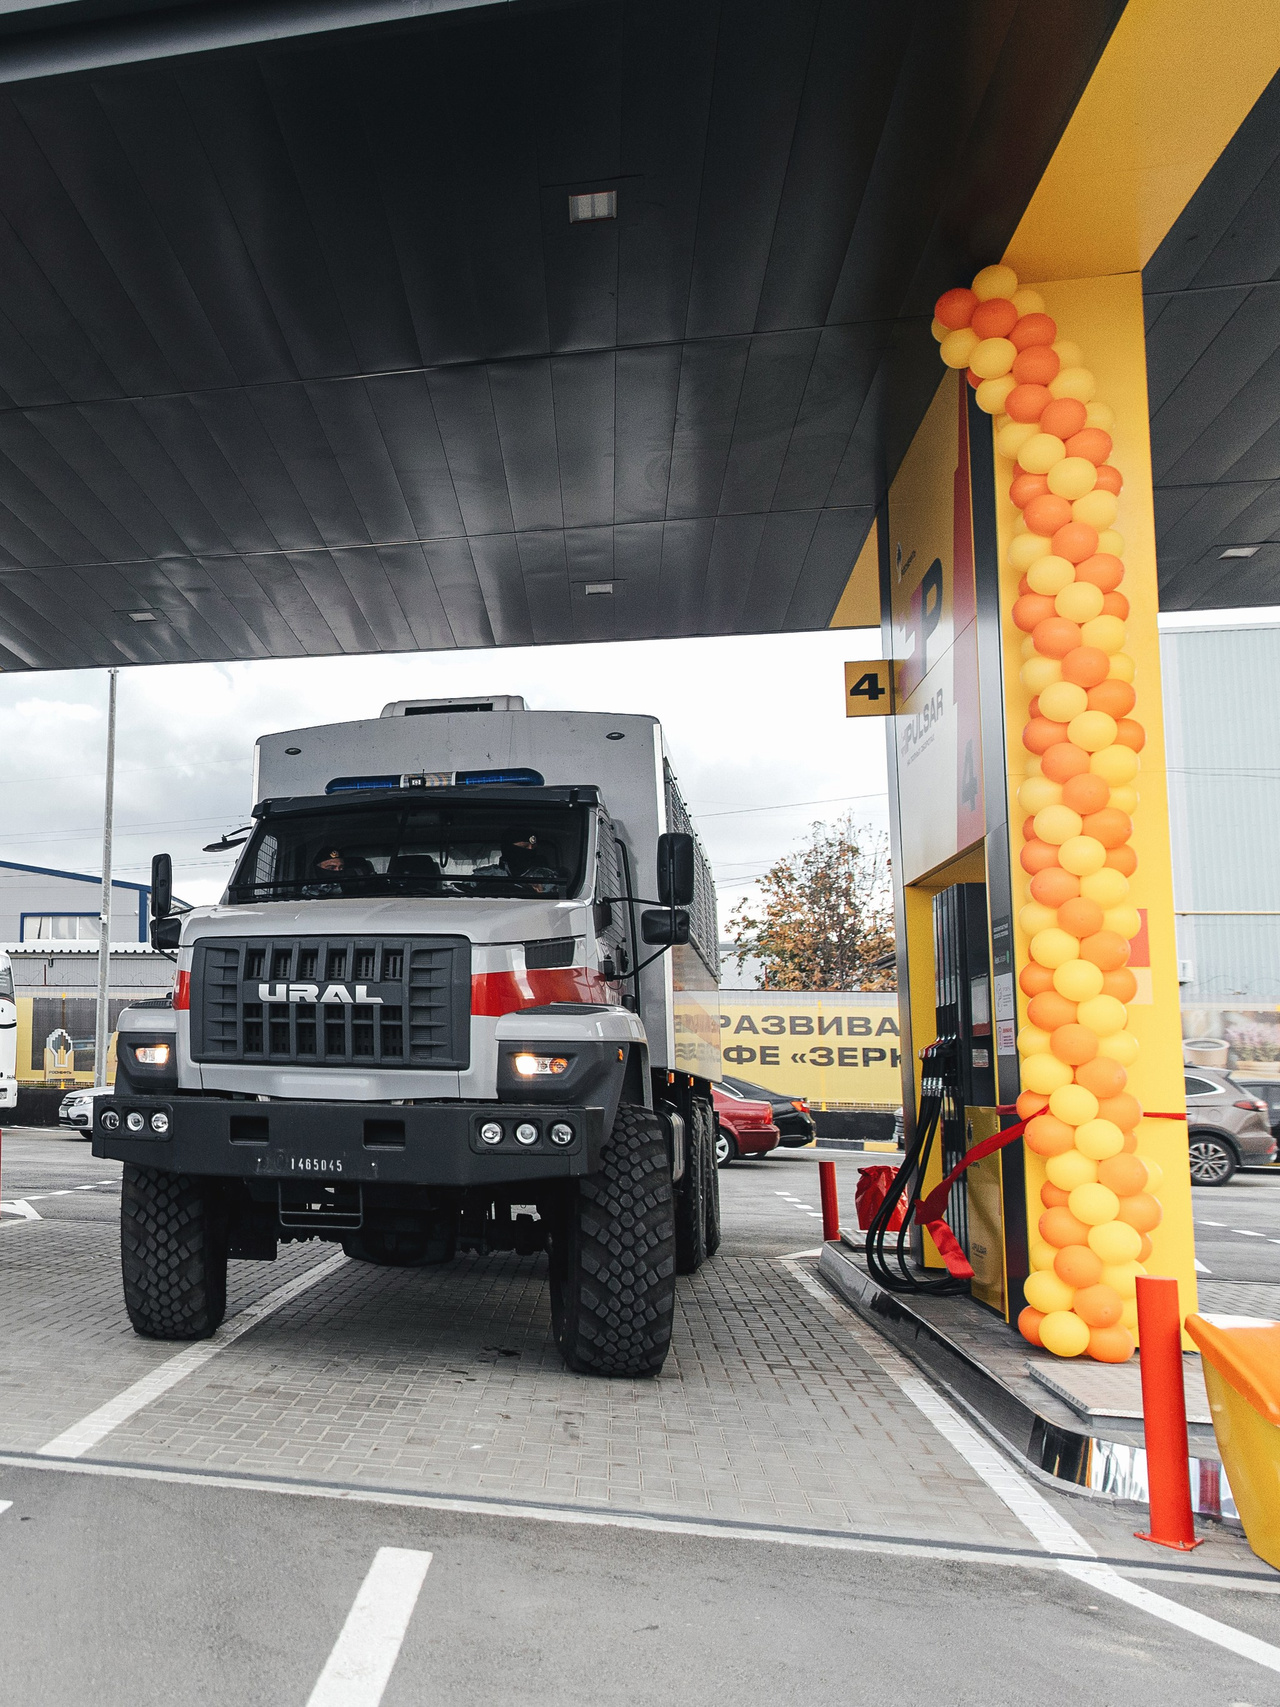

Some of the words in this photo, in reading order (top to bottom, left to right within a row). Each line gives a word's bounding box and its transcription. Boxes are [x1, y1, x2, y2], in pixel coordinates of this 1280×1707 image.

[850, 673, 886, 700] 4
[905, 688, 944, 748] PULSAR
[961, 737, 978, 812] 4
[258, 983, 384, 1004] URAL
[723, 1044, 780, 1066] ФЕ
[291, 1158, 343, 1172] 1465045
